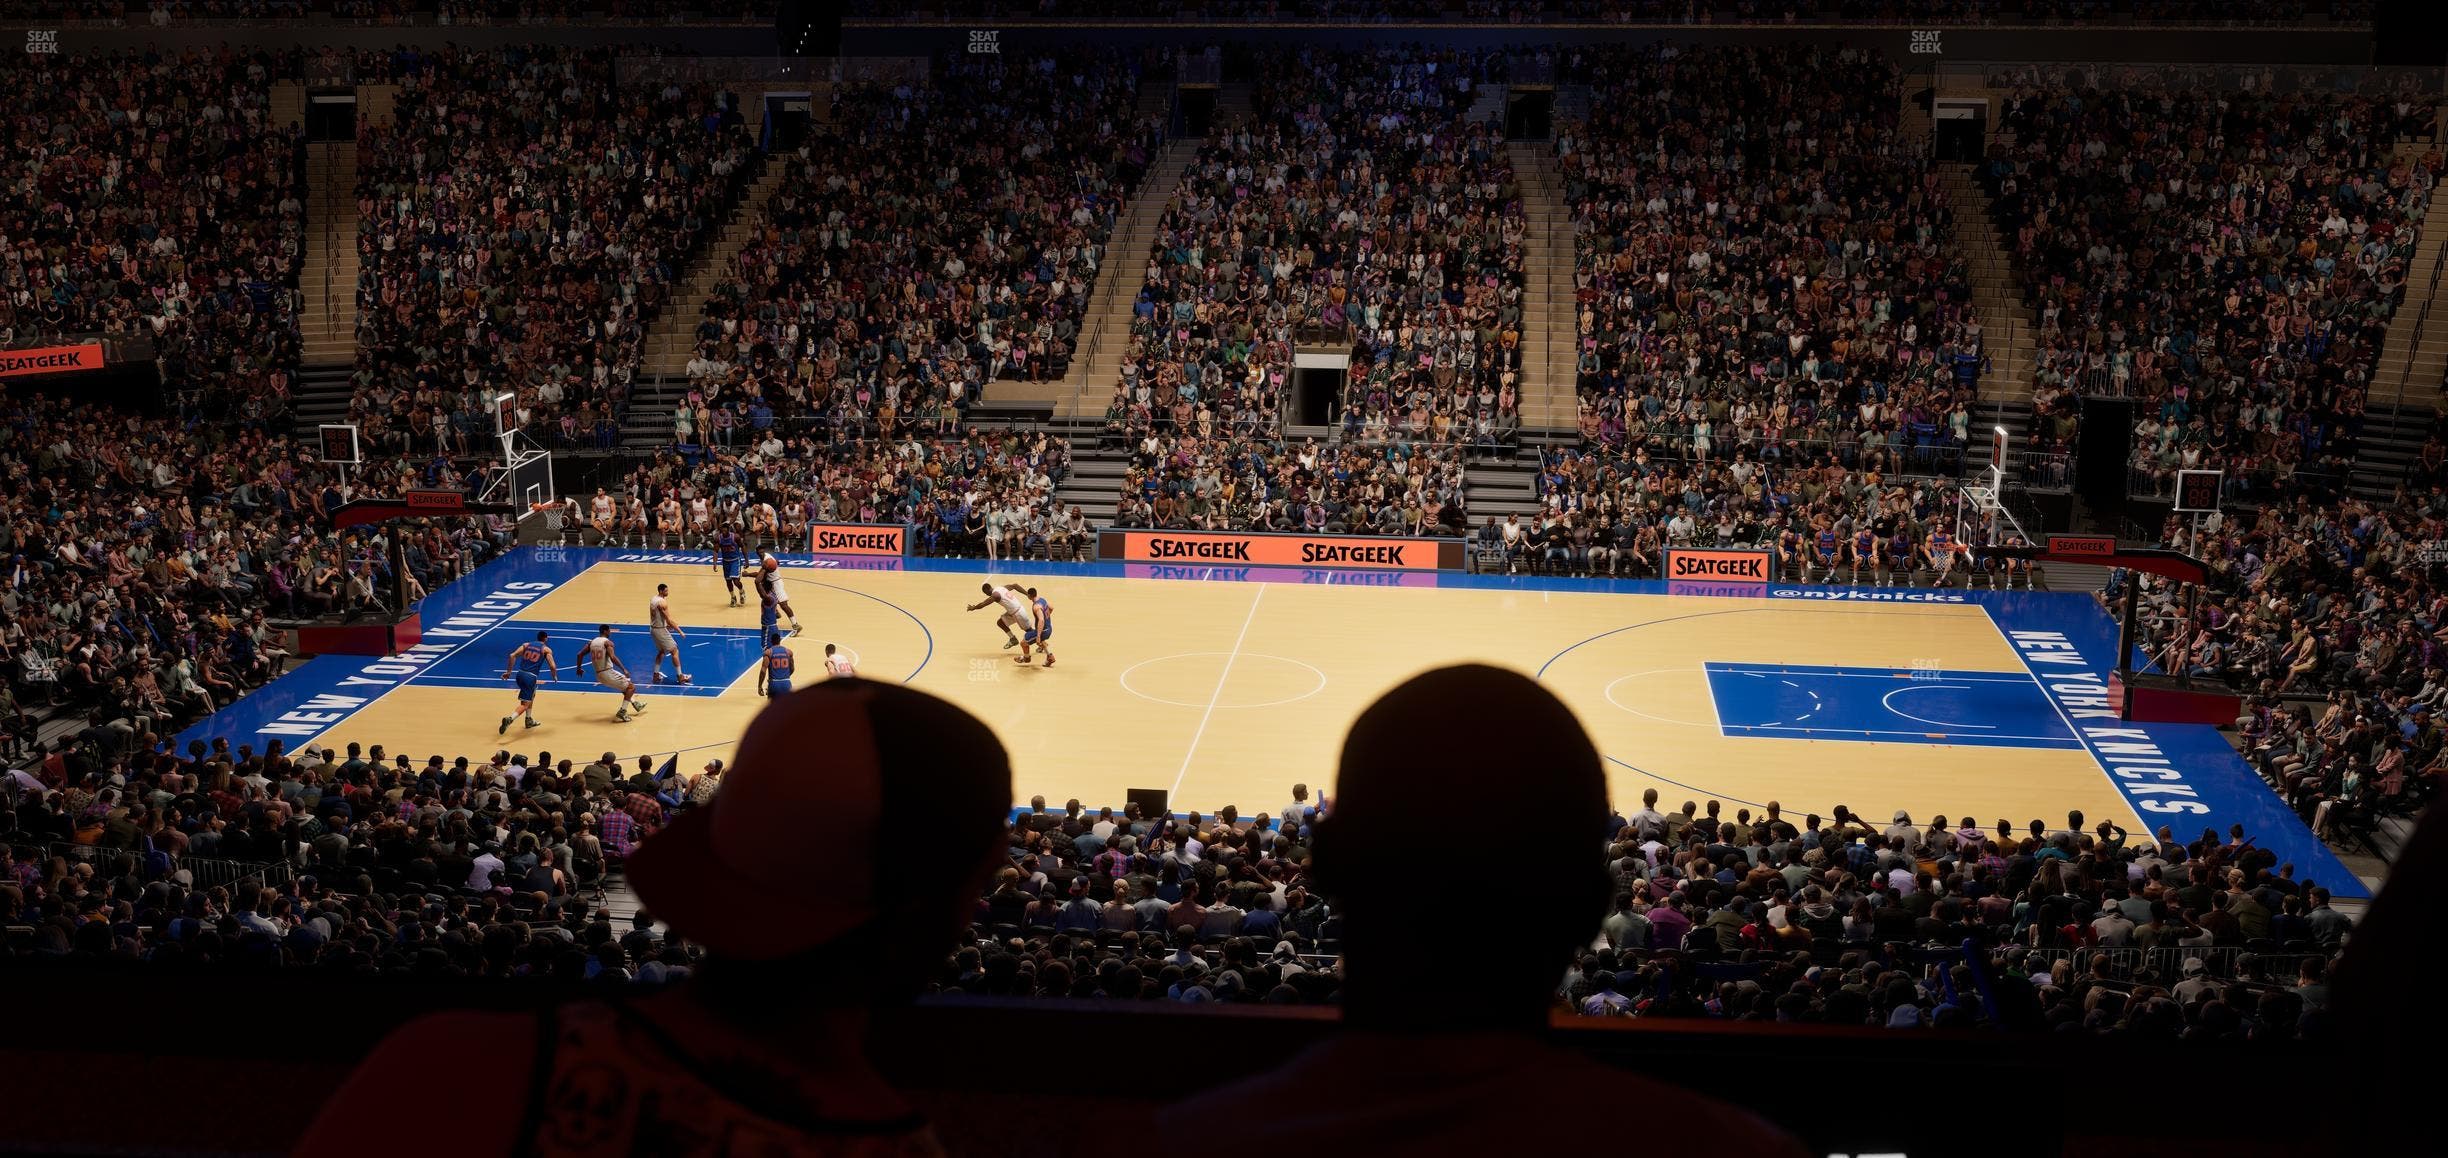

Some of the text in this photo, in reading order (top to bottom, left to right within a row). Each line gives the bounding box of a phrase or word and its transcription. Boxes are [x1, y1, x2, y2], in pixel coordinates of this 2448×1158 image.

[413, 494, 457, 506] SEATGEEK
[819, 531, 898, 552] SEATGEEK
[1149, 538, 1250, 561] SEATGEEK
[2057, 541, 2106, 552] SEATGEEK
[1302, 543, 1404, 566] SEATGEEK
[1676, 556, 1763, 578] SEATGEEK
[1772, 589, 1964, 603] @nyknicks
[255, 581, 555, 735] NEW YORK KNICKS
[772, 658, 789, 669] 00
[2008, 630, 2211, 815] NEW YORK KNICKS
